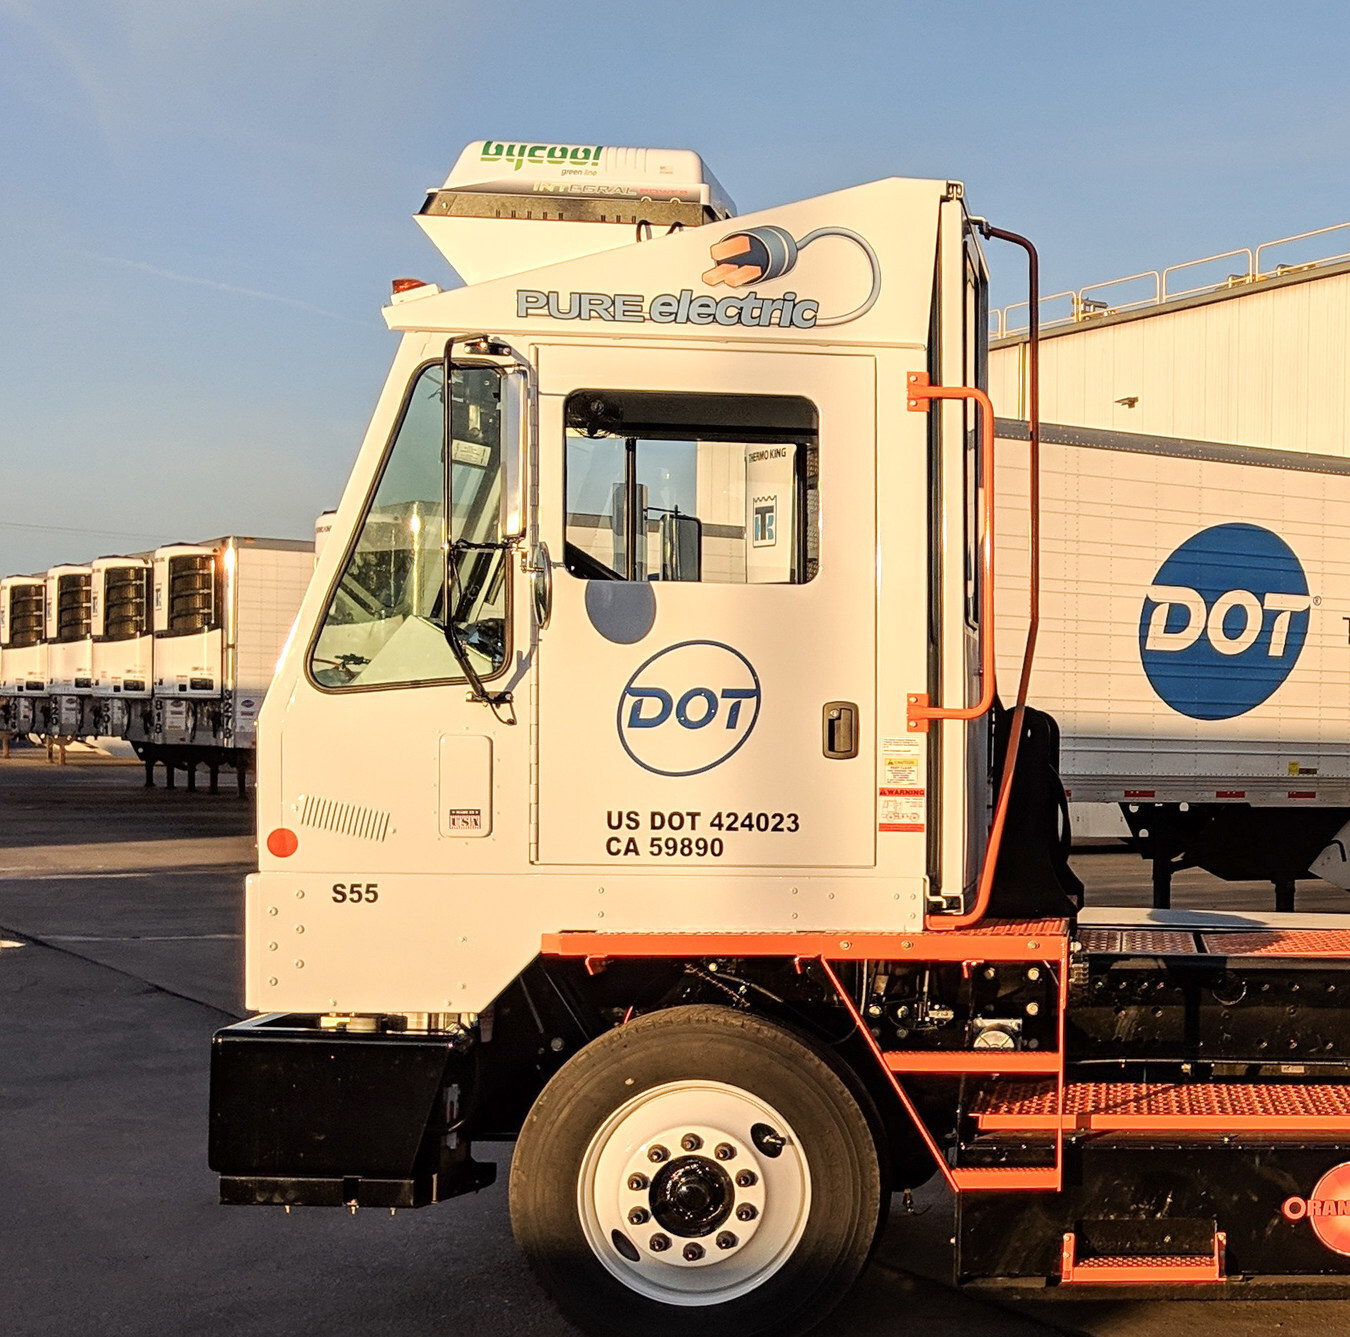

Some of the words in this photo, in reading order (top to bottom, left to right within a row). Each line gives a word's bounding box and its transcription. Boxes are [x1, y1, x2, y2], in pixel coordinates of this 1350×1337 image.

[480, 140, 603, 171] bycool
[561, 168, 583, 176] green
[533, 181, 637, 196] INTEGRAL
[516, 289, 645, 323] PURE
[649, 289, 819, 329] electric
[1145, 583, 1311, 658] DOT
[624, 686, 761, 730] DOT
[606, 811, 640, 830] US
[649, 811, 702, 831] DOT
[709, 812, 800, 832] 424023
[605, 836, 640, 857] CA
[649, 837, 724, 857] 59890
[331, 883, 379, 904] S55
